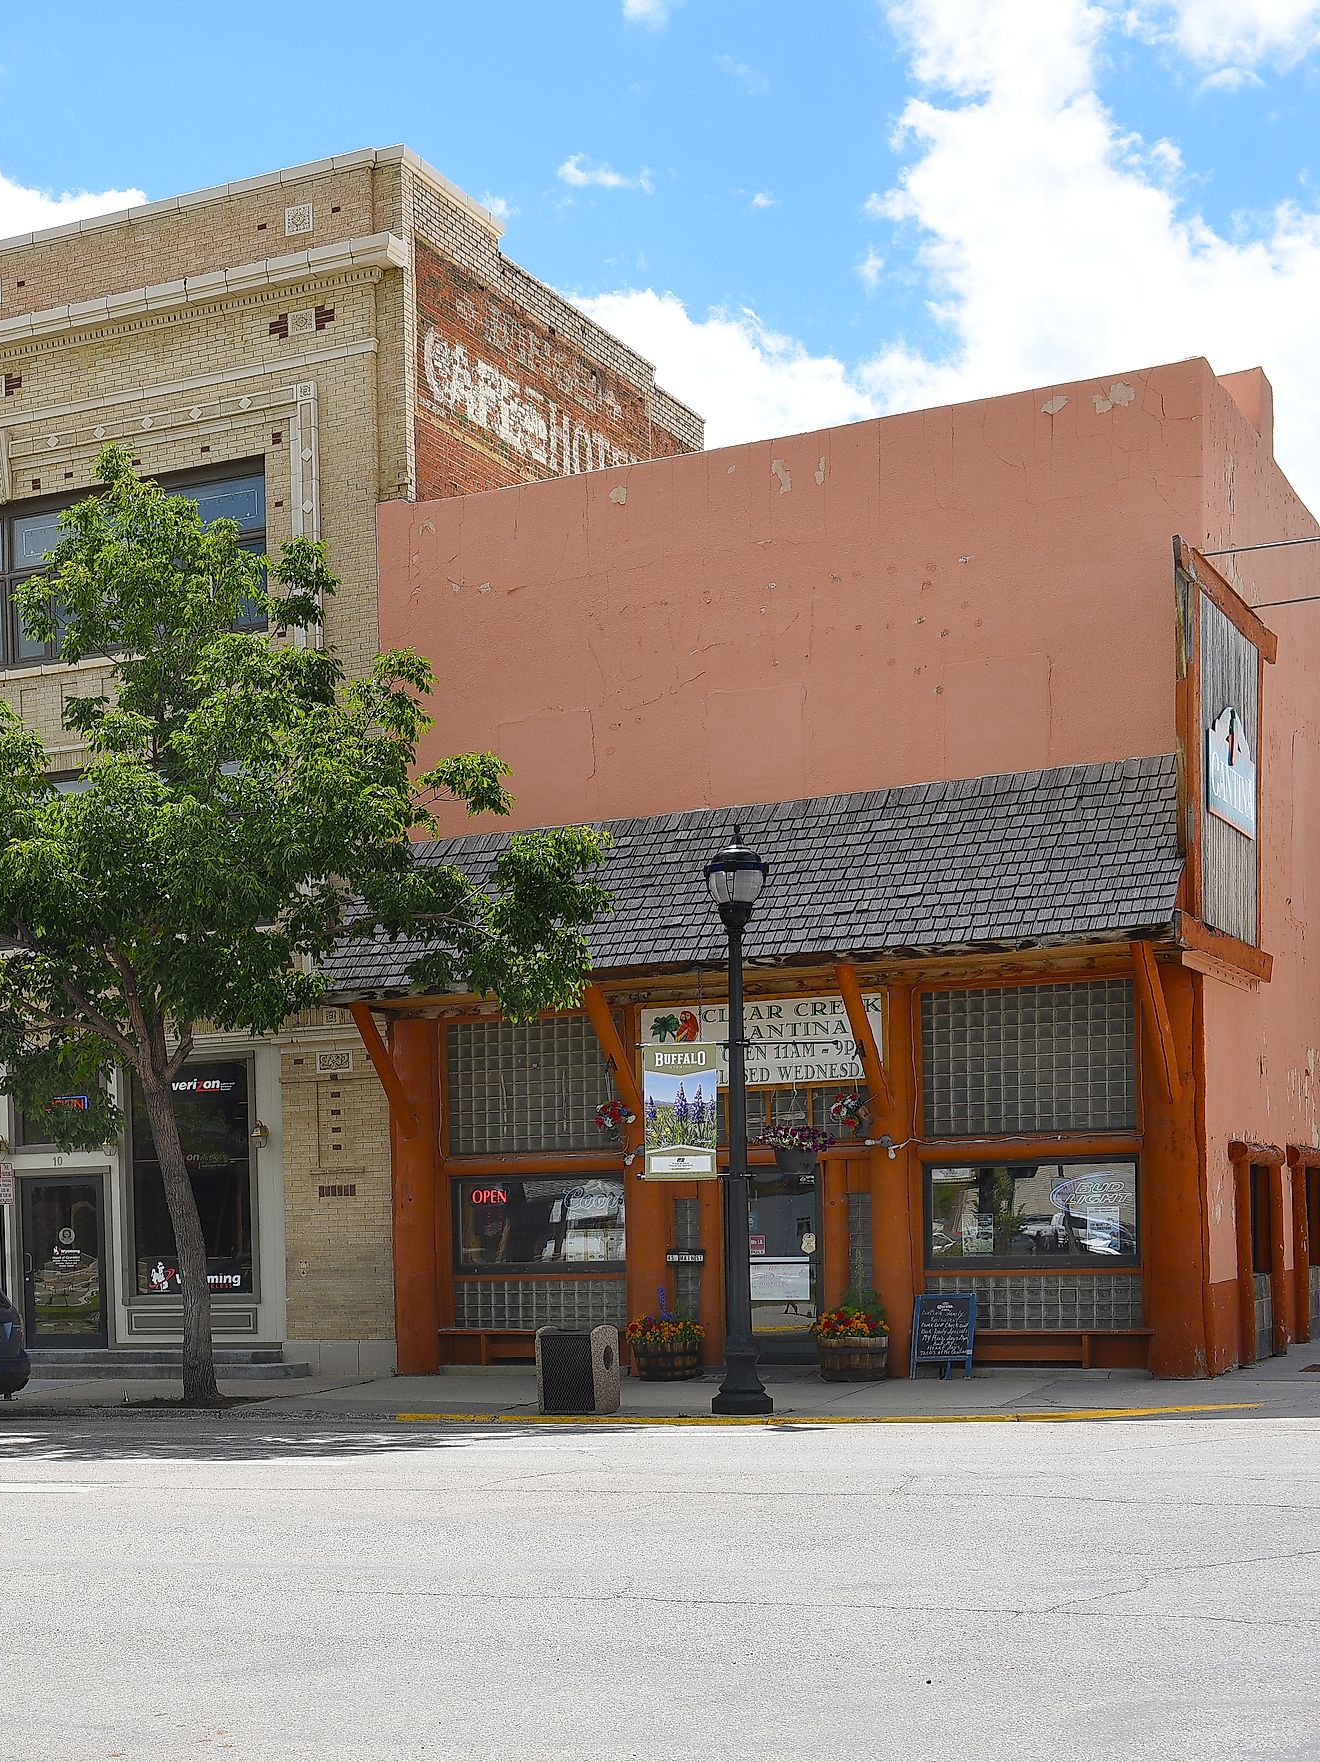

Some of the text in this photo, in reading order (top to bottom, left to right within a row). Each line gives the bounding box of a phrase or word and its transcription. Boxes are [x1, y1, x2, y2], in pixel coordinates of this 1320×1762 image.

[1212, 752, 1253, 822] CANTINA
[701, 996, 882, 1022] CLAR CREK
[742, 1020, 849, 1040] ANTINA
[654, 1050, 706, 1067] BUFFALO
[721, 1045, 768, 1062] OEN
[774, 1042, 816, 1060] 11AM
[835, 1039, 857, 1057] 9P
[716, 1061, 865, 1085] LSED WEDNESD
[172, 1079, 220, 1093] verizon
[53, 1156, 63, 1167] 10
[1075, 1181, 1125, 1194] BUD
[472, 1189, 508, 1204] OPEN
[1064, 1192, 1132, 1205] LIGHT
